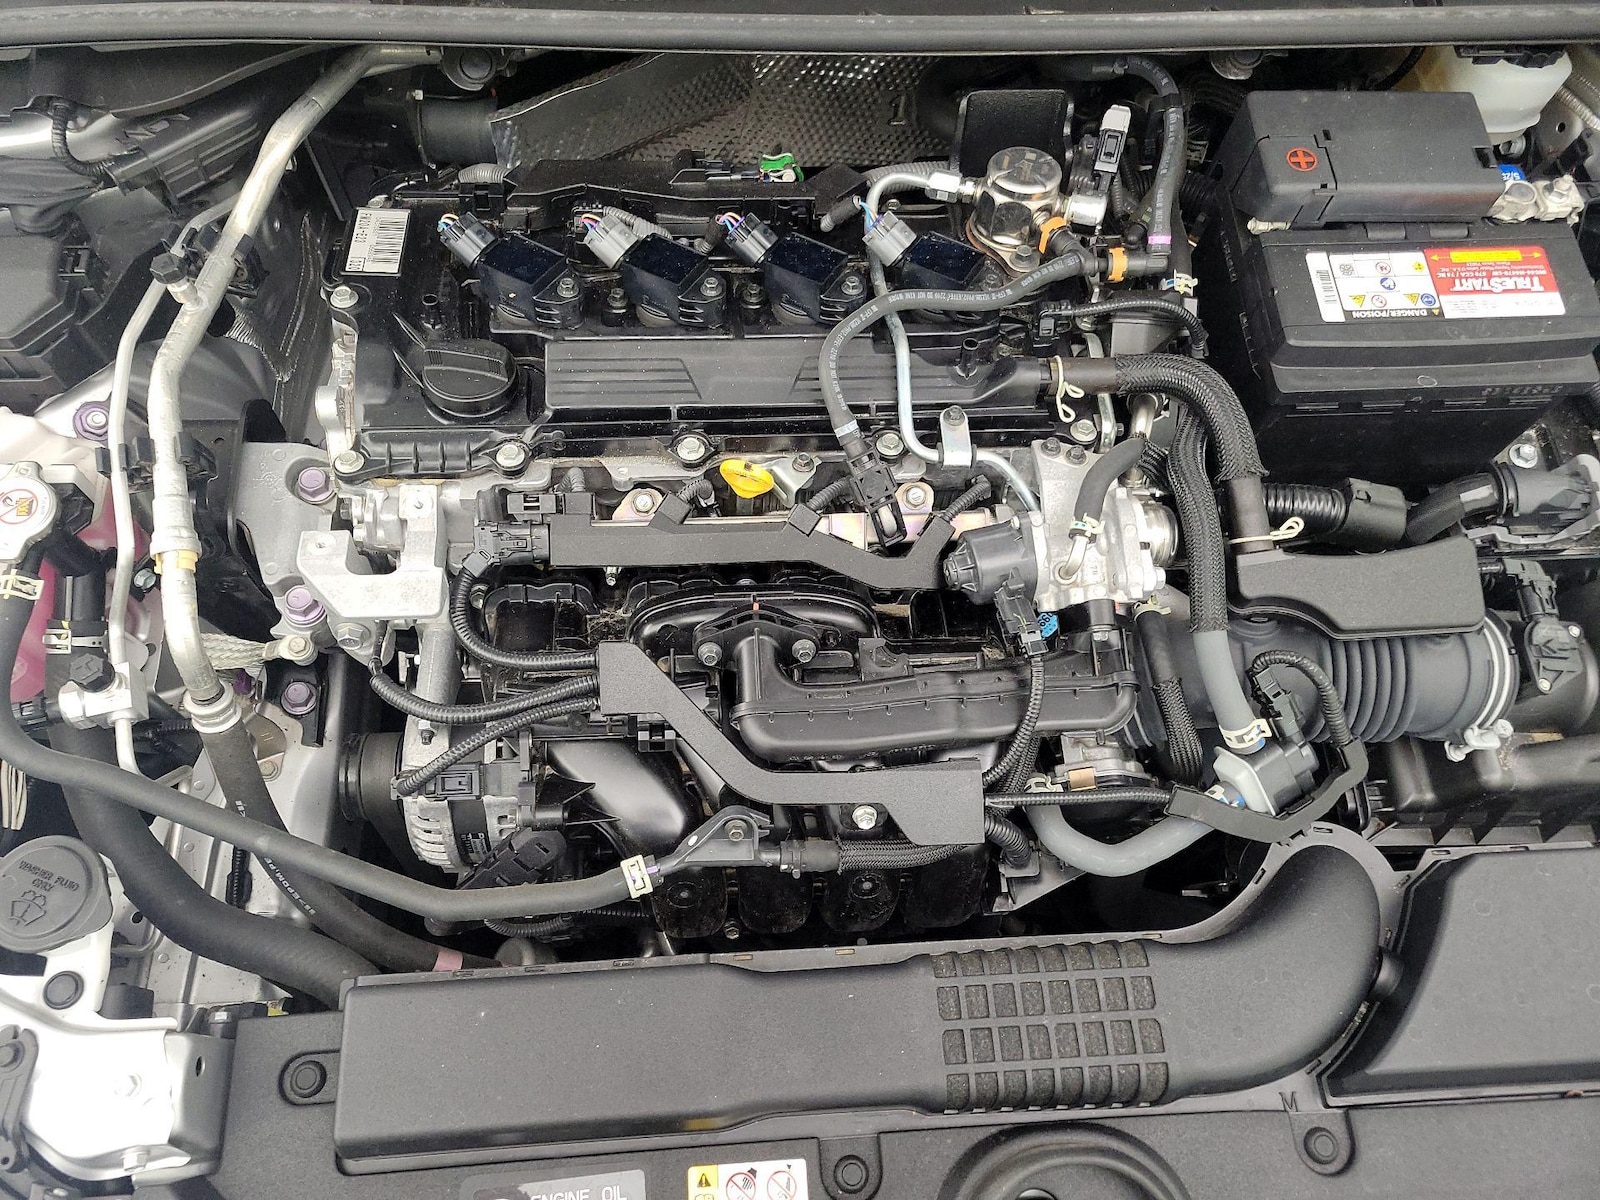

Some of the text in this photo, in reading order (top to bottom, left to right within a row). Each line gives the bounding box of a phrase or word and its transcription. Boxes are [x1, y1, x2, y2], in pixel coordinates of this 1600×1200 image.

[19, 860, 80, 892] WASHER FLUID
[32, 878, 55, 892] ONLY
[602, 1185, 628, 1200] OIL
